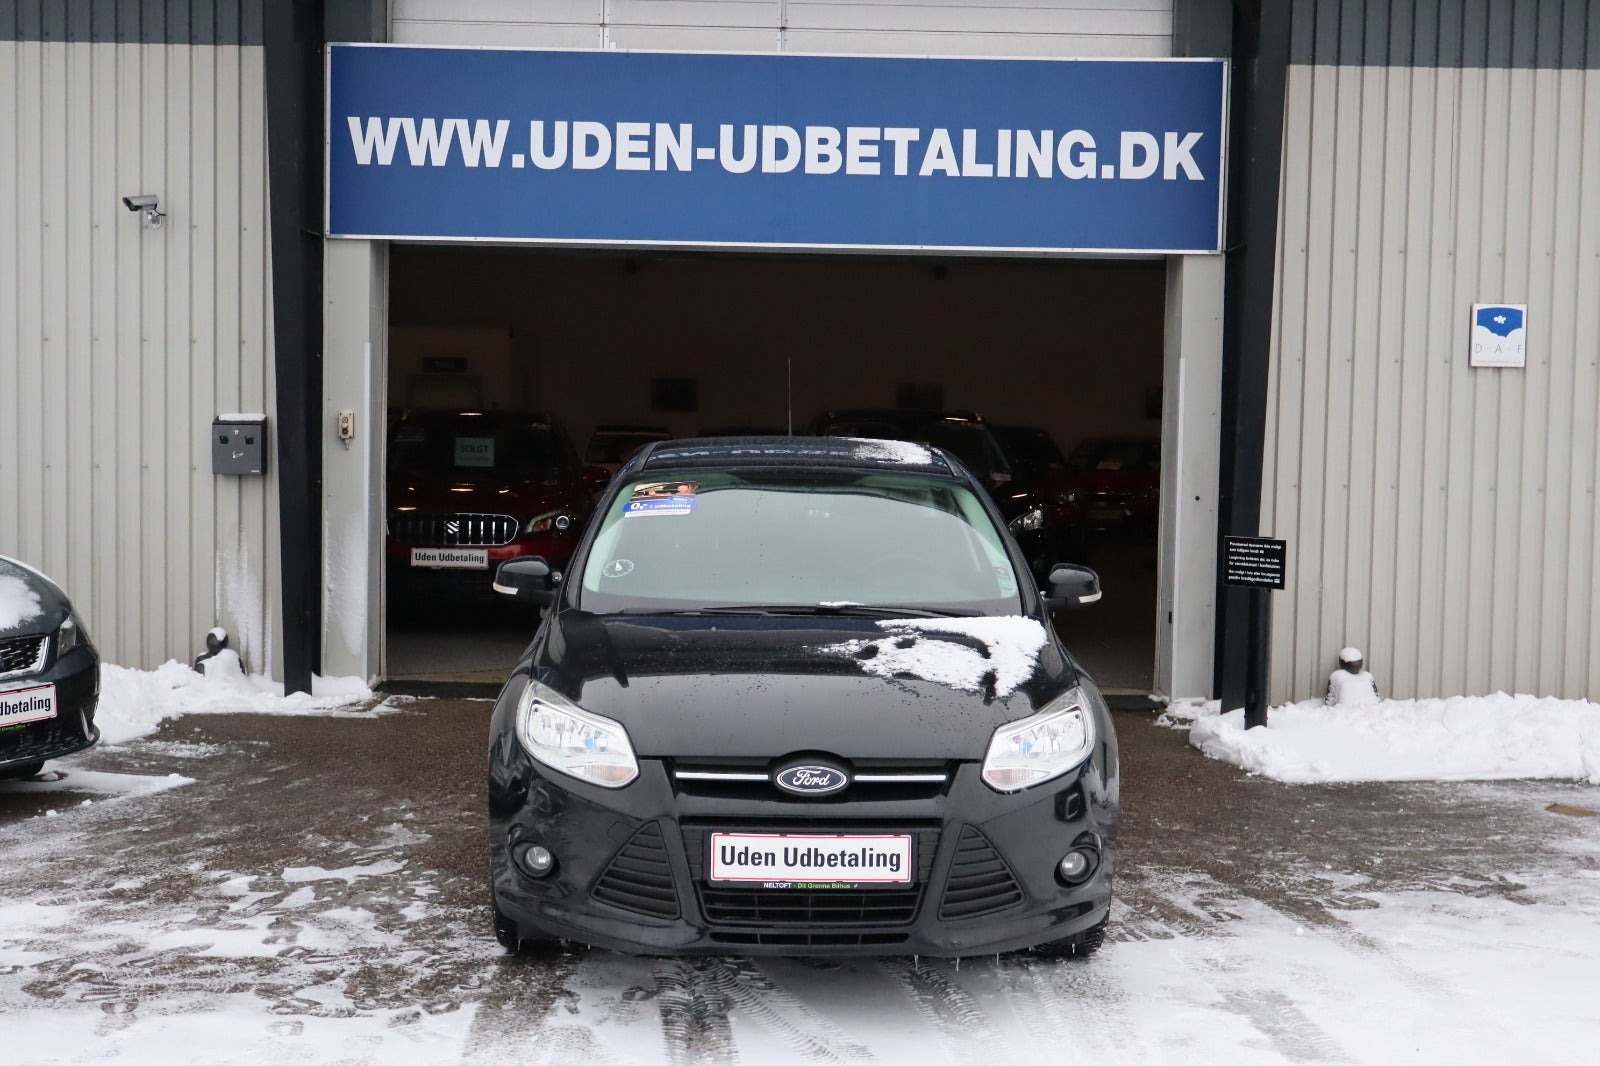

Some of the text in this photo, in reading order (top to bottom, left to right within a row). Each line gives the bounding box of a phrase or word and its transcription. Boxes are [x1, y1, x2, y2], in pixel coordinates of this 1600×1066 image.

[347, 116, 1205, 181] WWW.UDEN-UDBETALING.DK
[415, 552, 485, 563] Uden Udbetaling
[792, 769, 831, 786] Ford
[720, 845, 901, 872] Uden Udbetaling
